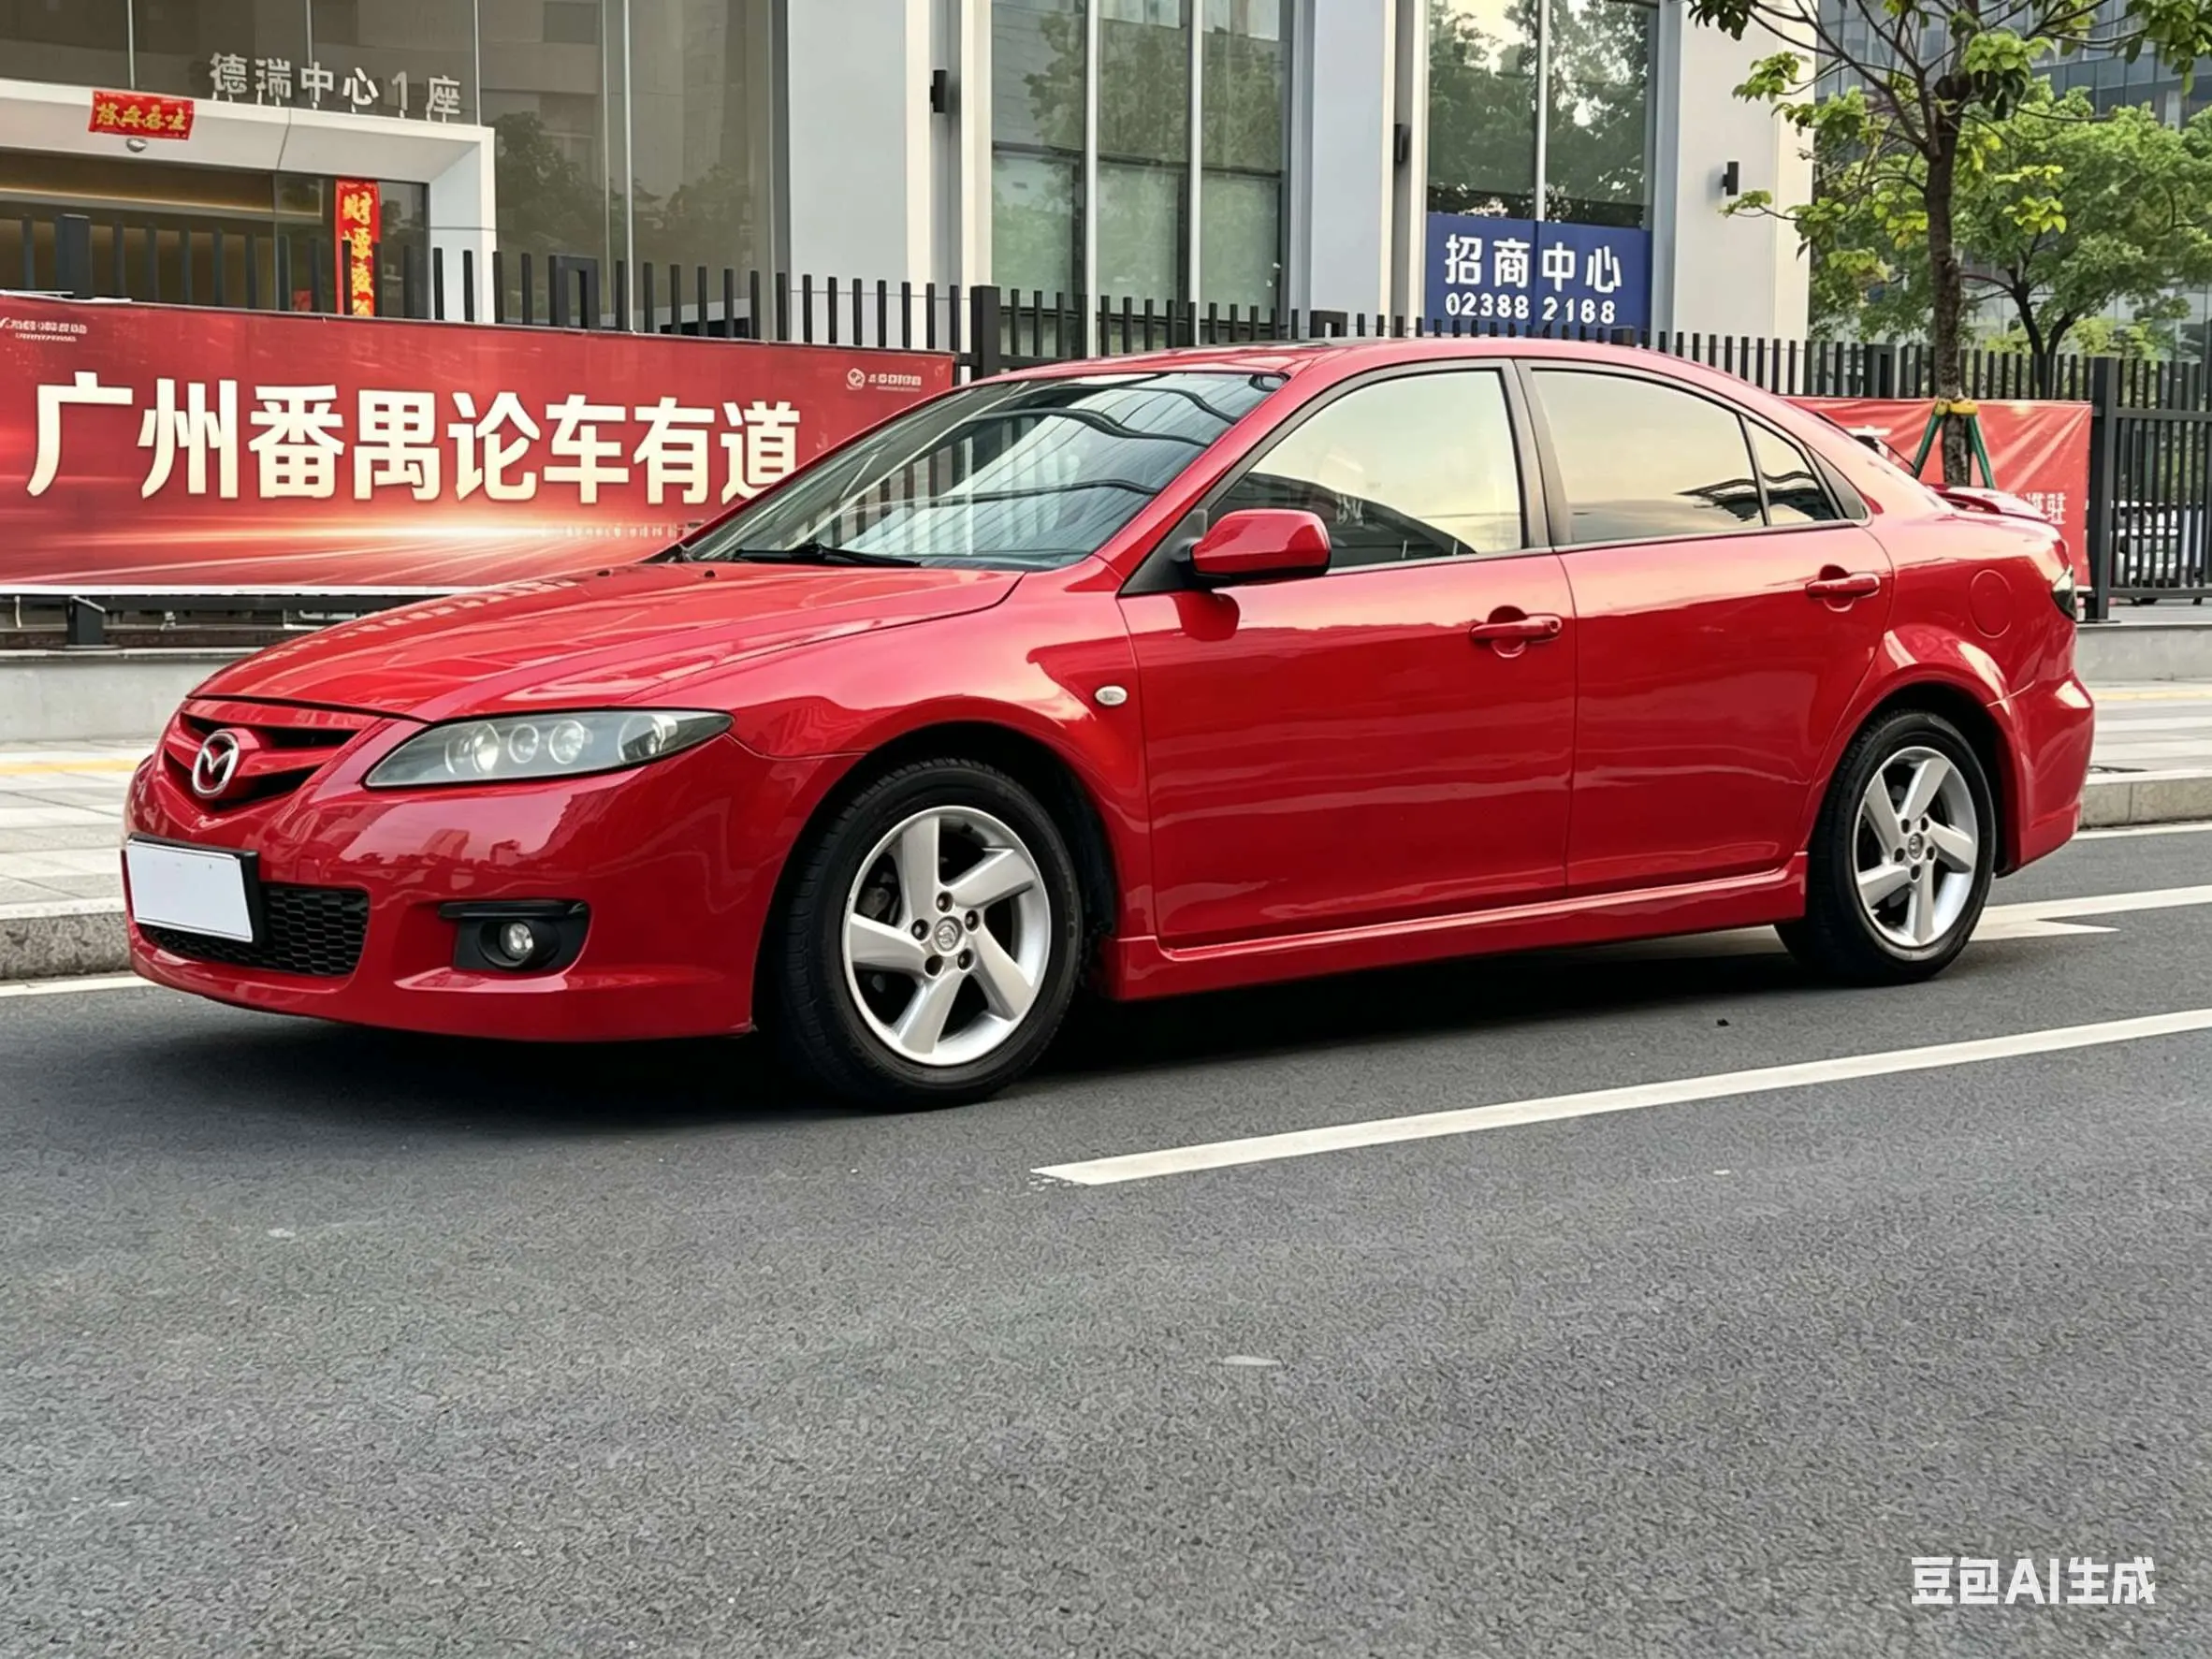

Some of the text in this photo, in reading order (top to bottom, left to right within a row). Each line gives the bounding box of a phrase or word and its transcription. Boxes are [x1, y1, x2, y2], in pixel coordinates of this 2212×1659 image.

[1444, 233, 1623, 294] 招商中心
[1445, 291, 1616, 325] 02388 2188
[25, 371, 801, 506] 广州番禺论车有道
